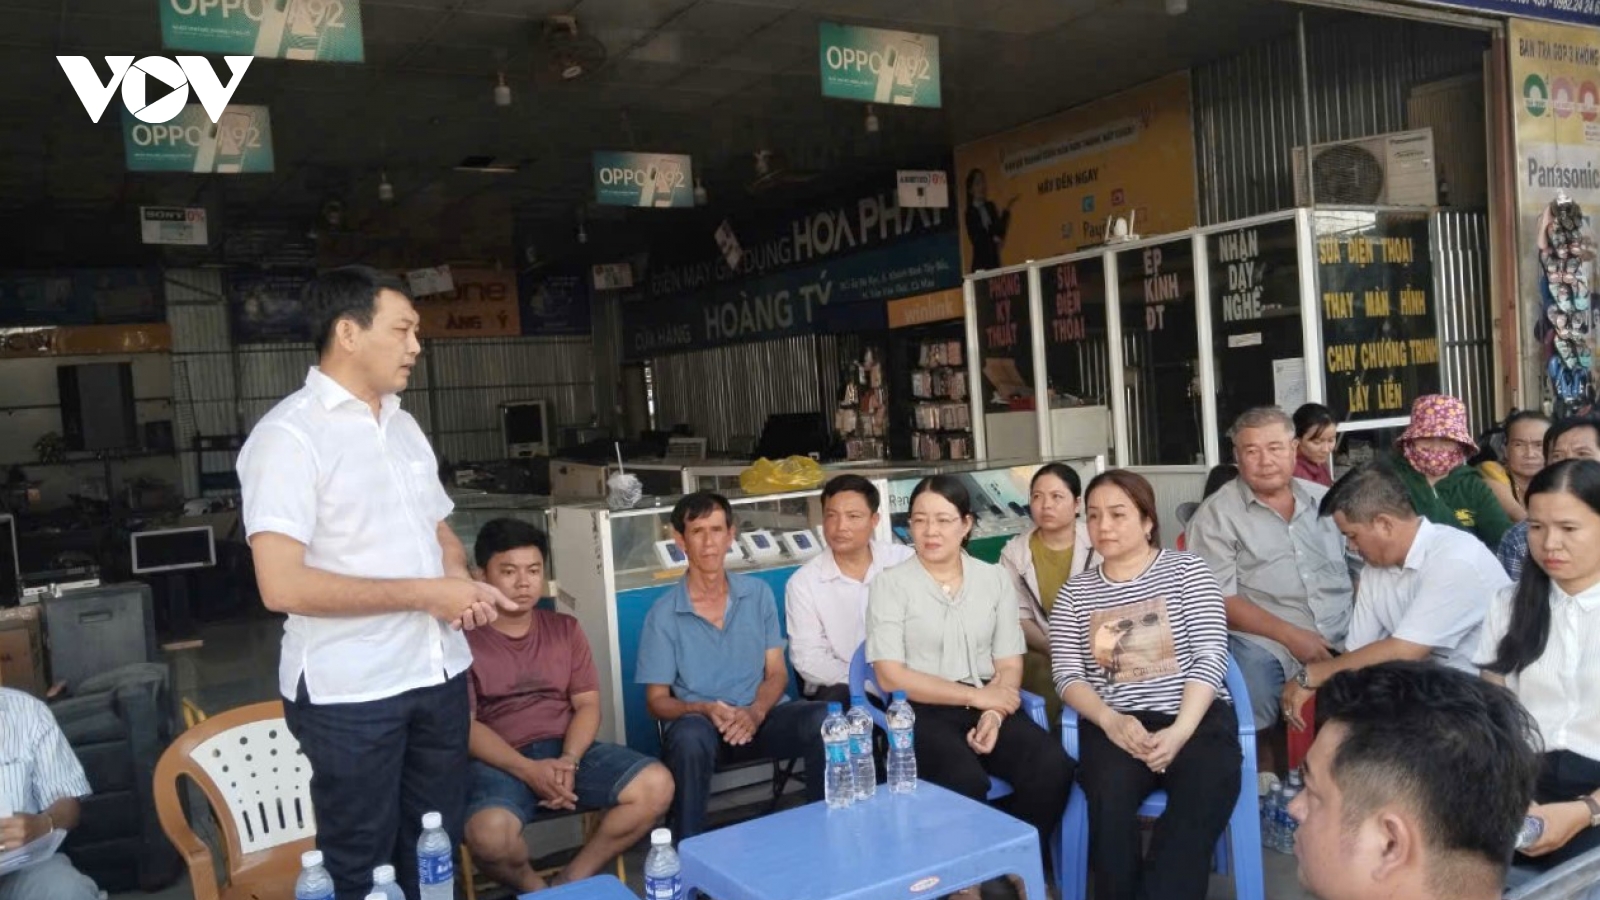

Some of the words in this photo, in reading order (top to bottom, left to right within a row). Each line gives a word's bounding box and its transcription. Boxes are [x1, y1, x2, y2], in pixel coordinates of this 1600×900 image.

[826, 45, 884, 74] OPPO
[131, 124, 202, 147] OPPO
[599, 167, 648, 187] OPPO
[1075, 167, 1099, 186] NGAY
[1527, 156, 1600, 189] Panasonic
[146, 210, 184, 220] SONY
[1228, 261, 1255, 292] DẠY
[702, 289, 794, 340] HOÀNG
[1323, 292, 1354, 319] THAY
[1364, 286, 1390, 317] MÀN
[1327, 343, 1357, 376] CHẠY
[1348, 376, 1370, 413] LẤY
